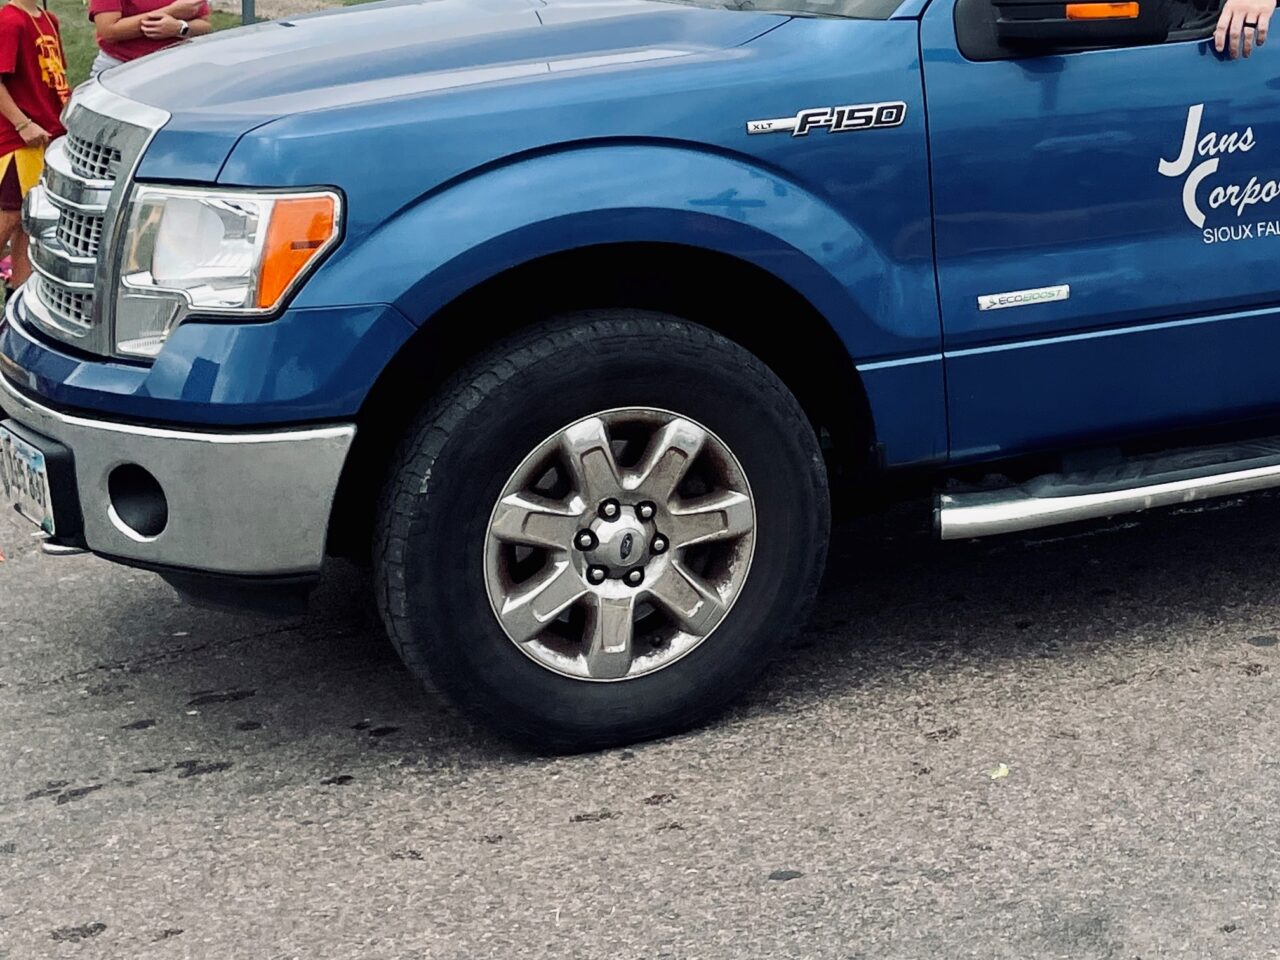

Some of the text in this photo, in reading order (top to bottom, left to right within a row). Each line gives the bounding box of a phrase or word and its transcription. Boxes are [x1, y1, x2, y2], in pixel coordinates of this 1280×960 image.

[752, 101, 907, 136] XLT F-150
[1157, 103, 1256, 177] Jans
[1203, 223, 1253, 244] SIOUX
[998, 289, 1062, 306] ECOBOOST
